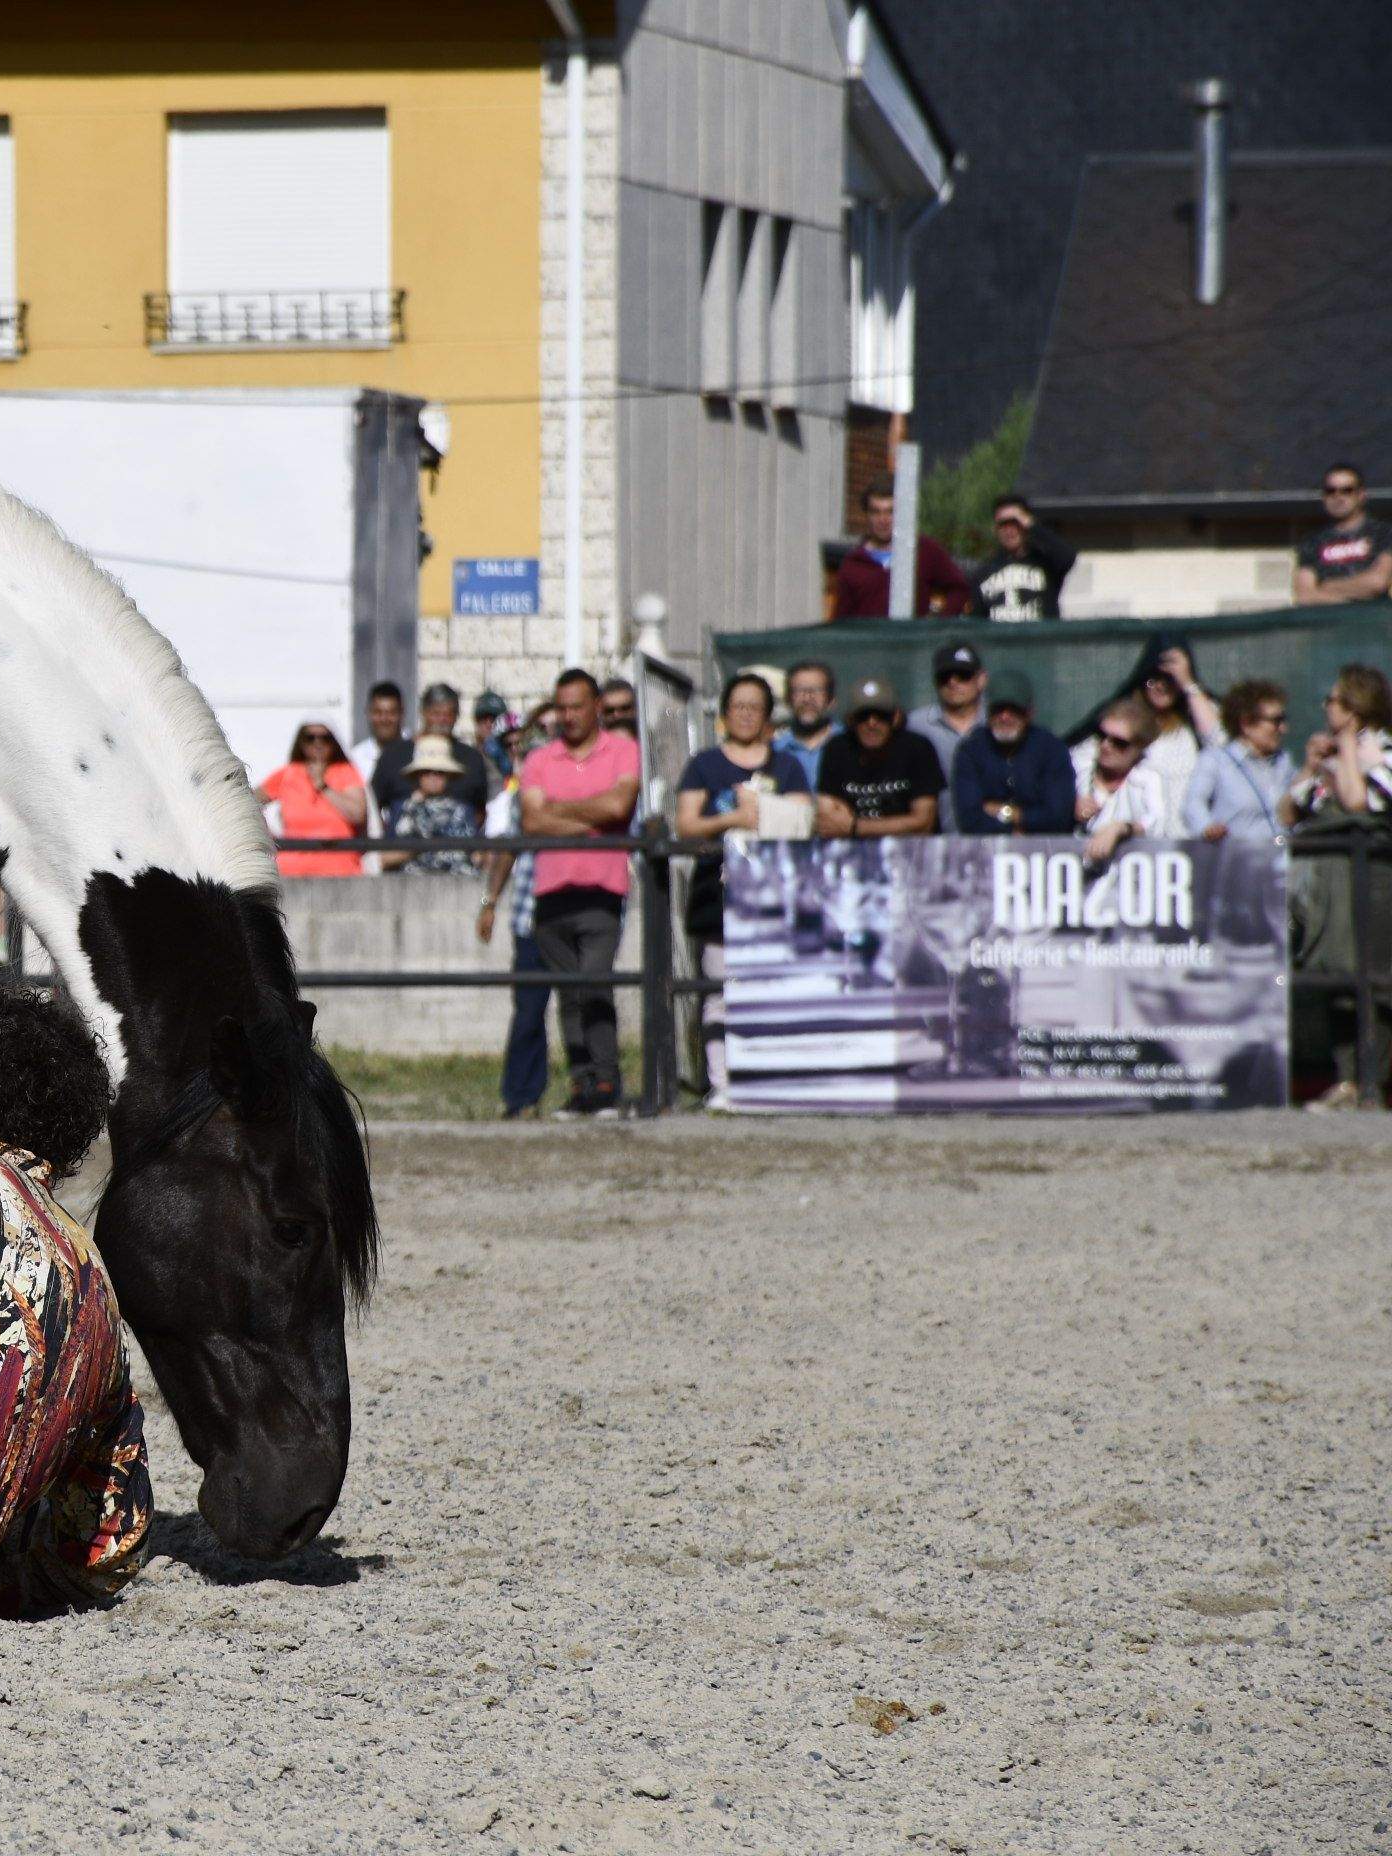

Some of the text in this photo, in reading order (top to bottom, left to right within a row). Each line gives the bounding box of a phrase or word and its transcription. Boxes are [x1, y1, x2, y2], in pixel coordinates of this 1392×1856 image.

[476, 559, 526, 577] CALLE
[993, 852, 1193, 930] RIAZOR
[1085, 935, 1214, 968] Restaurante
